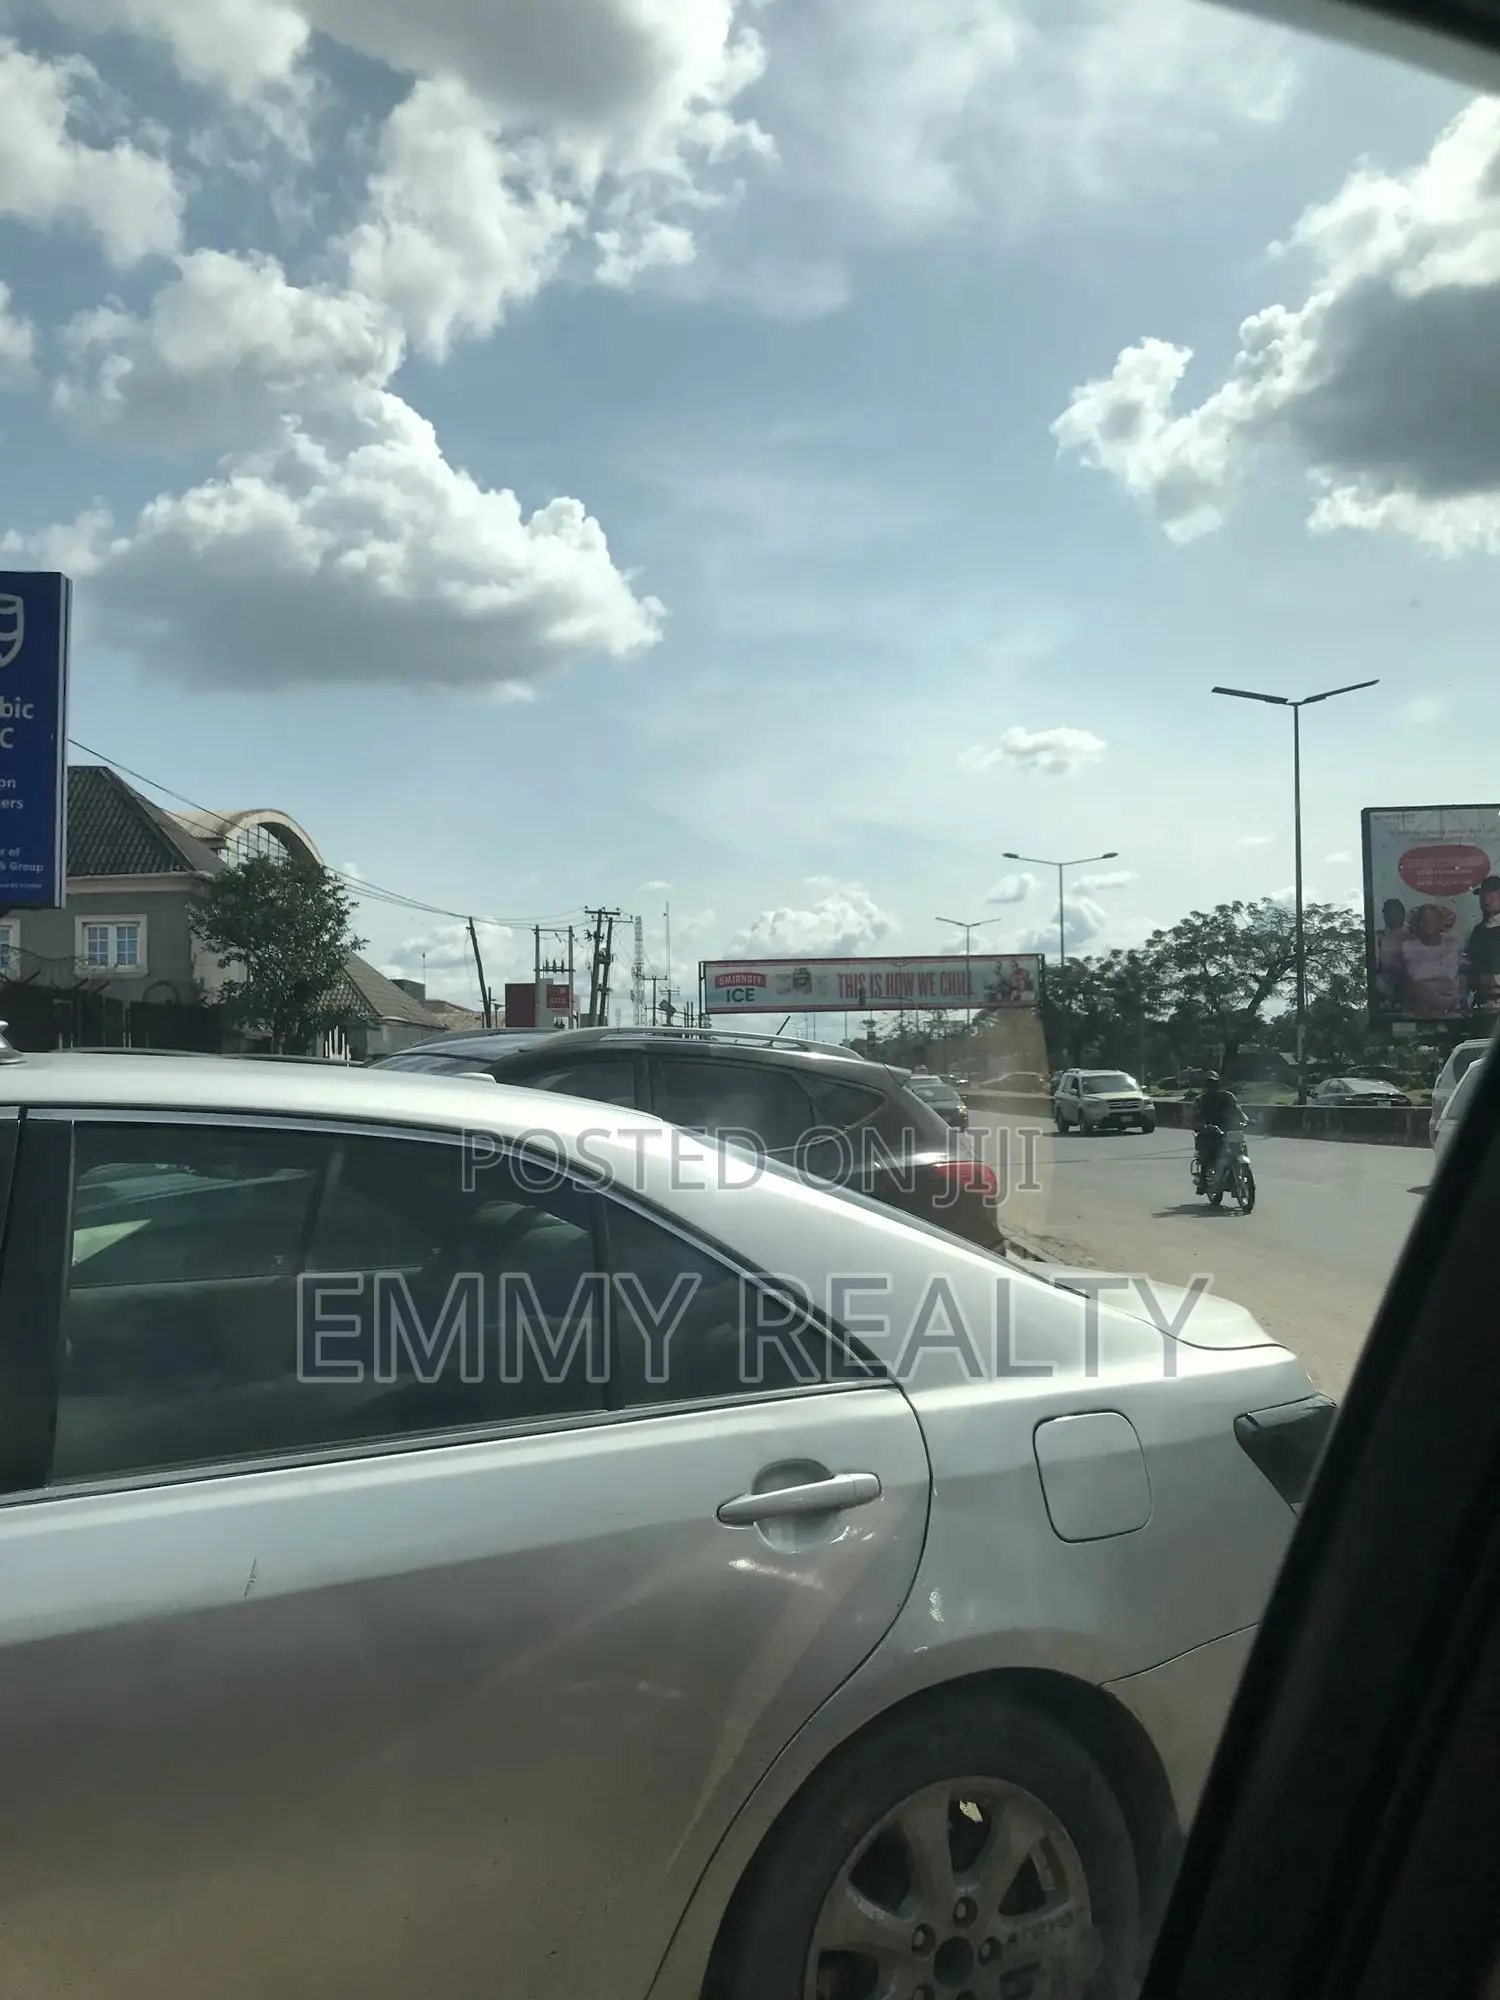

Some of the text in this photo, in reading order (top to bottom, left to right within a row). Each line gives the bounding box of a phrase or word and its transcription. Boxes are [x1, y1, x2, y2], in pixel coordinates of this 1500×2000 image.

[9, 861, 44, 874] Group
[837, 972, 866, 998] THIS
[870, 972, 882, 997] IS
[885, 972, 914, 996] HOW
[917, 972, 937, 996] WE
[726, 988, 755, 1002] ICE
